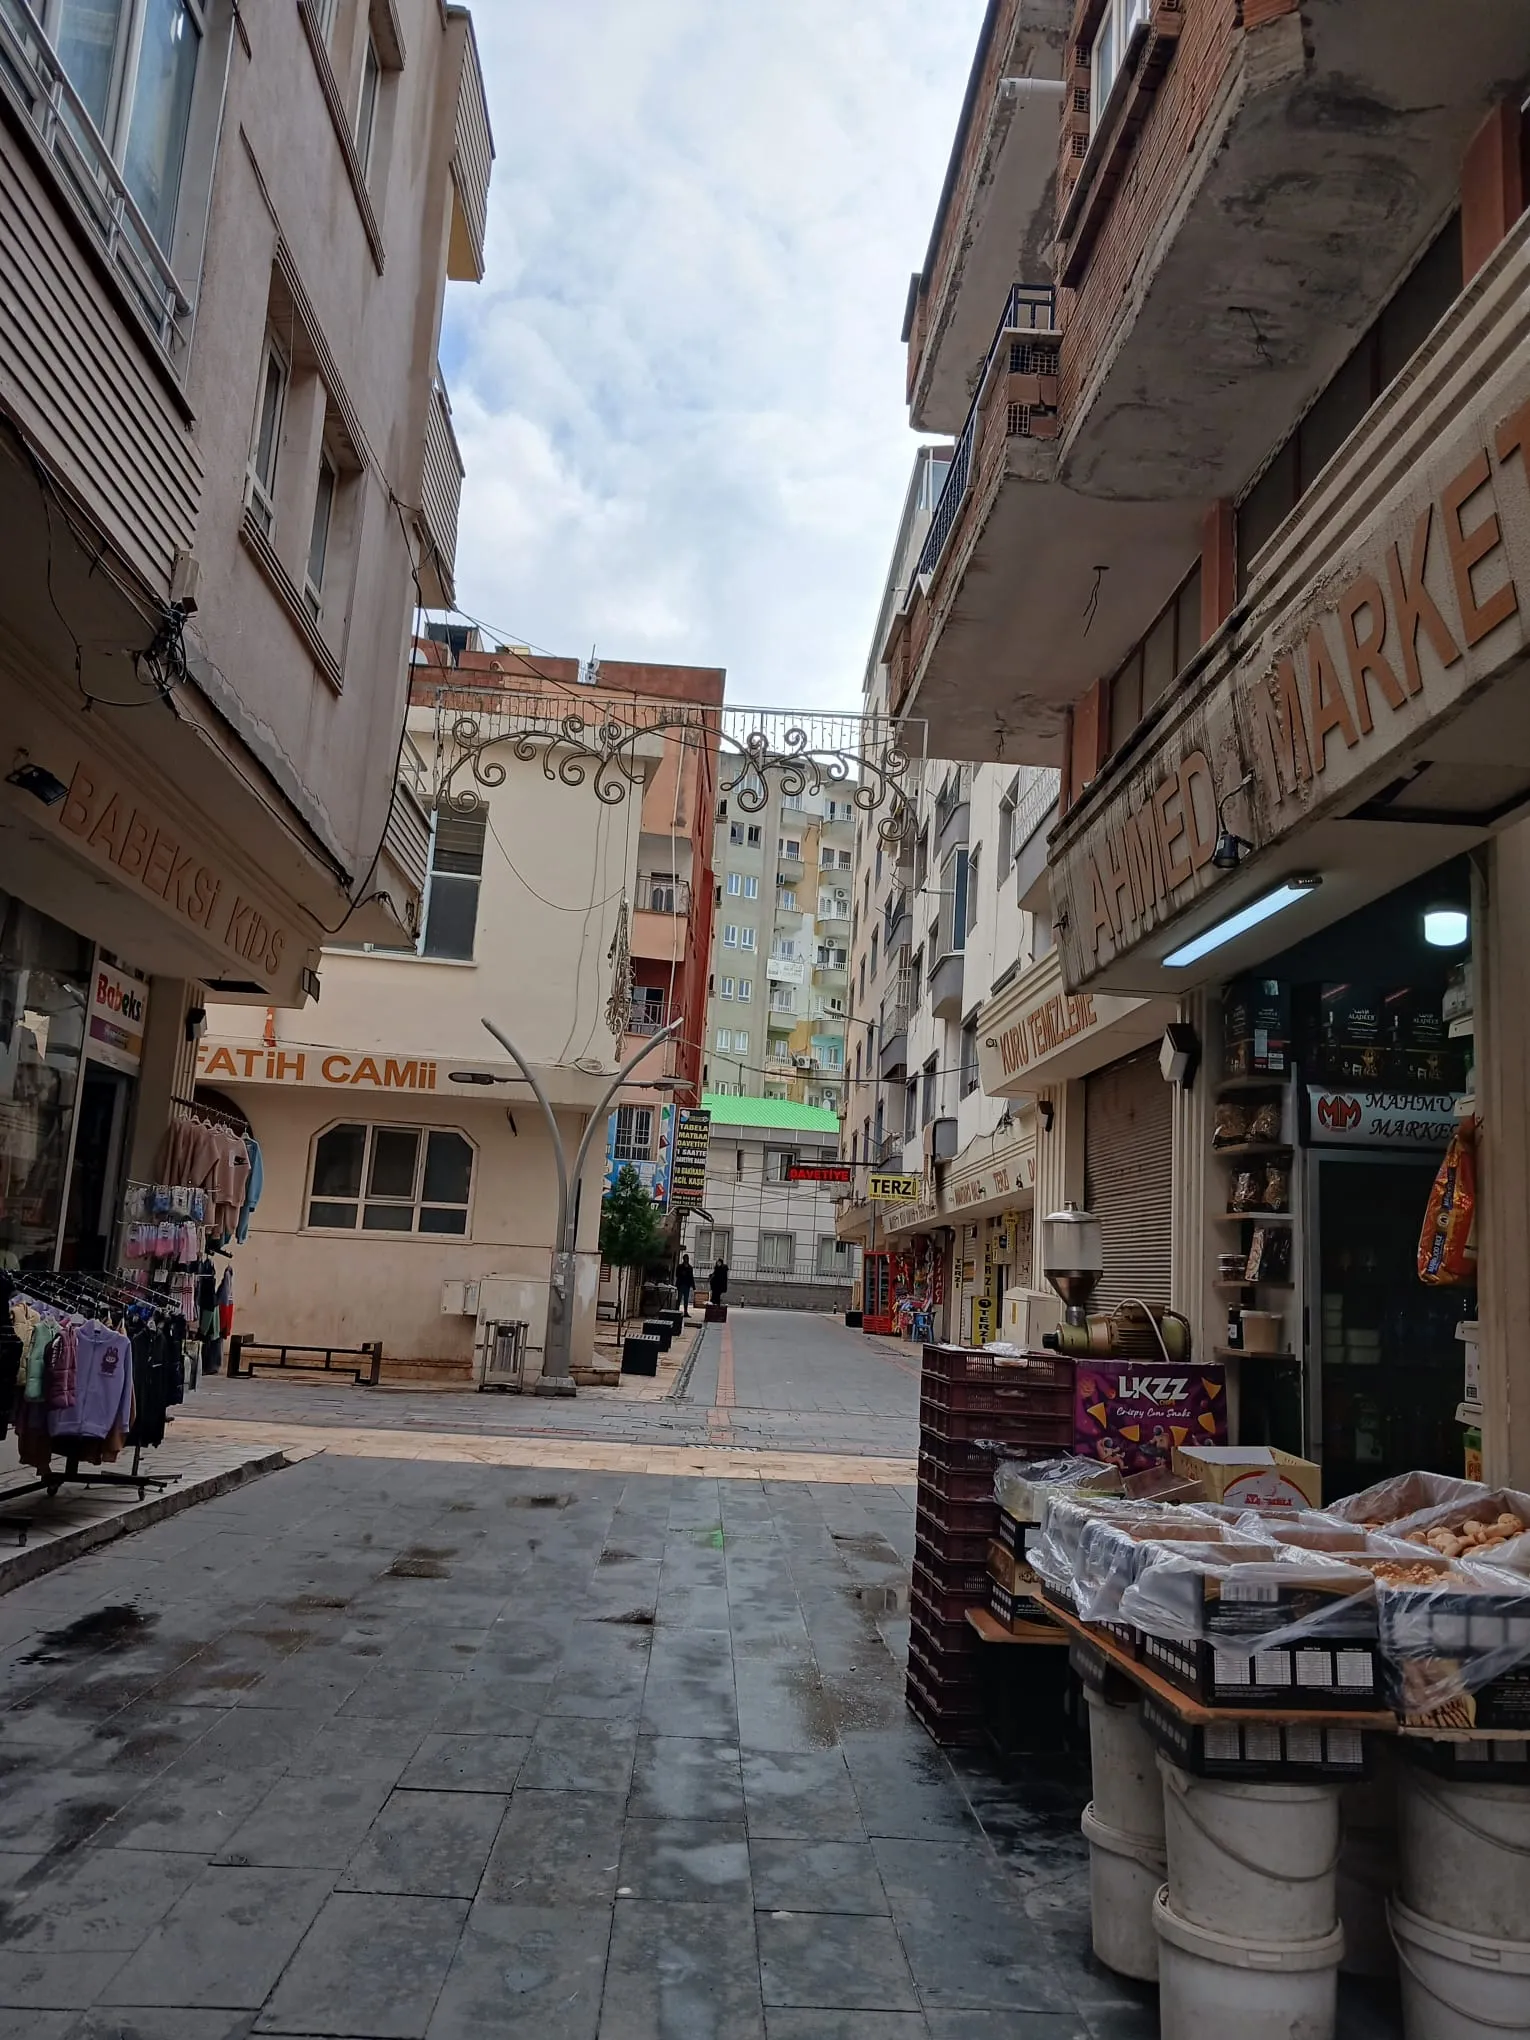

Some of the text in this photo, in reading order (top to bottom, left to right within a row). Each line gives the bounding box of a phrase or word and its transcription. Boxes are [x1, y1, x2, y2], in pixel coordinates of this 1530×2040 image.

[1087, 750, 1221, 952] AHMED
[999, 1019, 1029, 1076] KURU
[1365, 1093, 1456, 1113] MAHMU
[680, 1124, 709, 1132] TABELA
[789, 1168, 849, 1181] DAVETİYE
[1118, 1375, 1189, 1406] LKZZ
